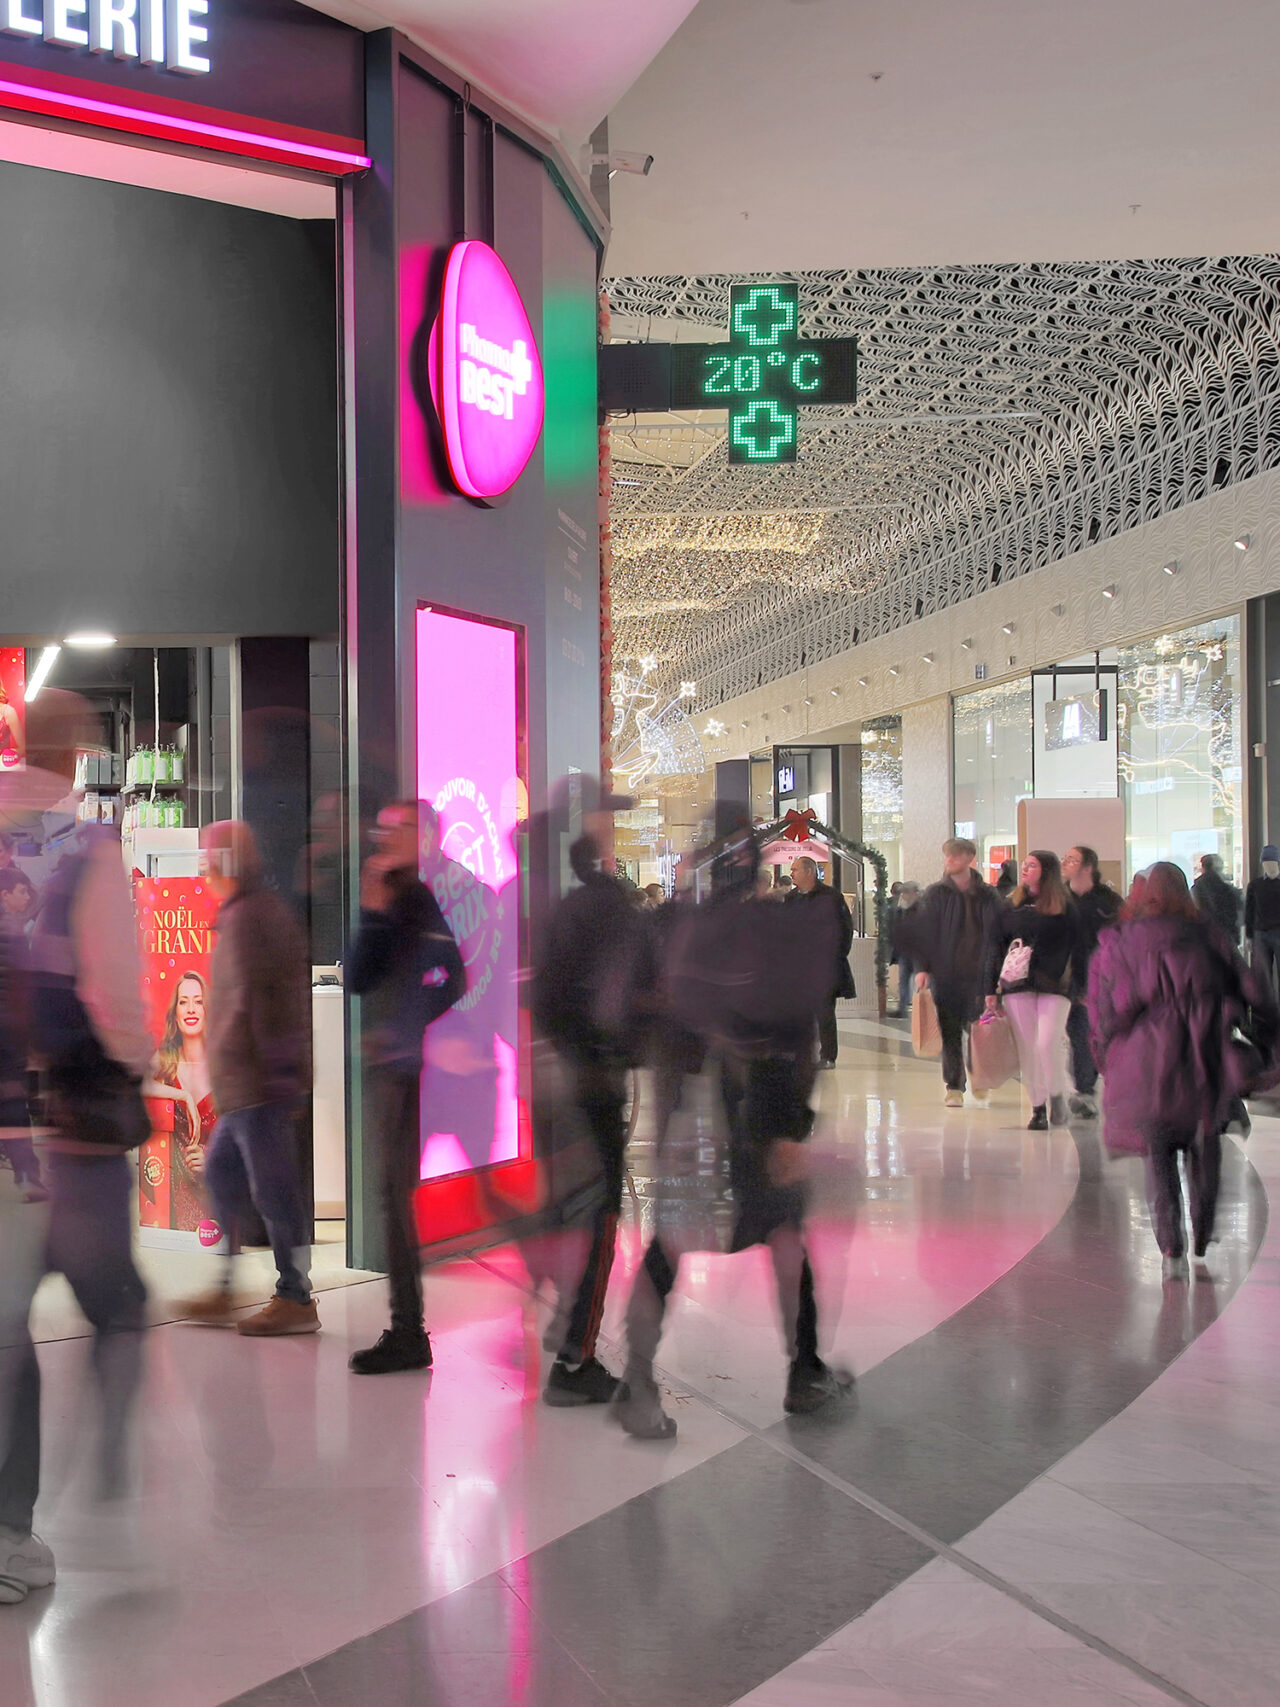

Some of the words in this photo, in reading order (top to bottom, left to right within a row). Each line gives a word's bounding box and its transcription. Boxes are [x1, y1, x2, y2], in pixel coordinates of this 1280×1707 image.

[705, 351, 819, 392] 20°C
[477, 792, 504, 879] D'ACHAT
[153, 906, 198, 928] NOËL
[452, 964, 492, 1012] POUVO
